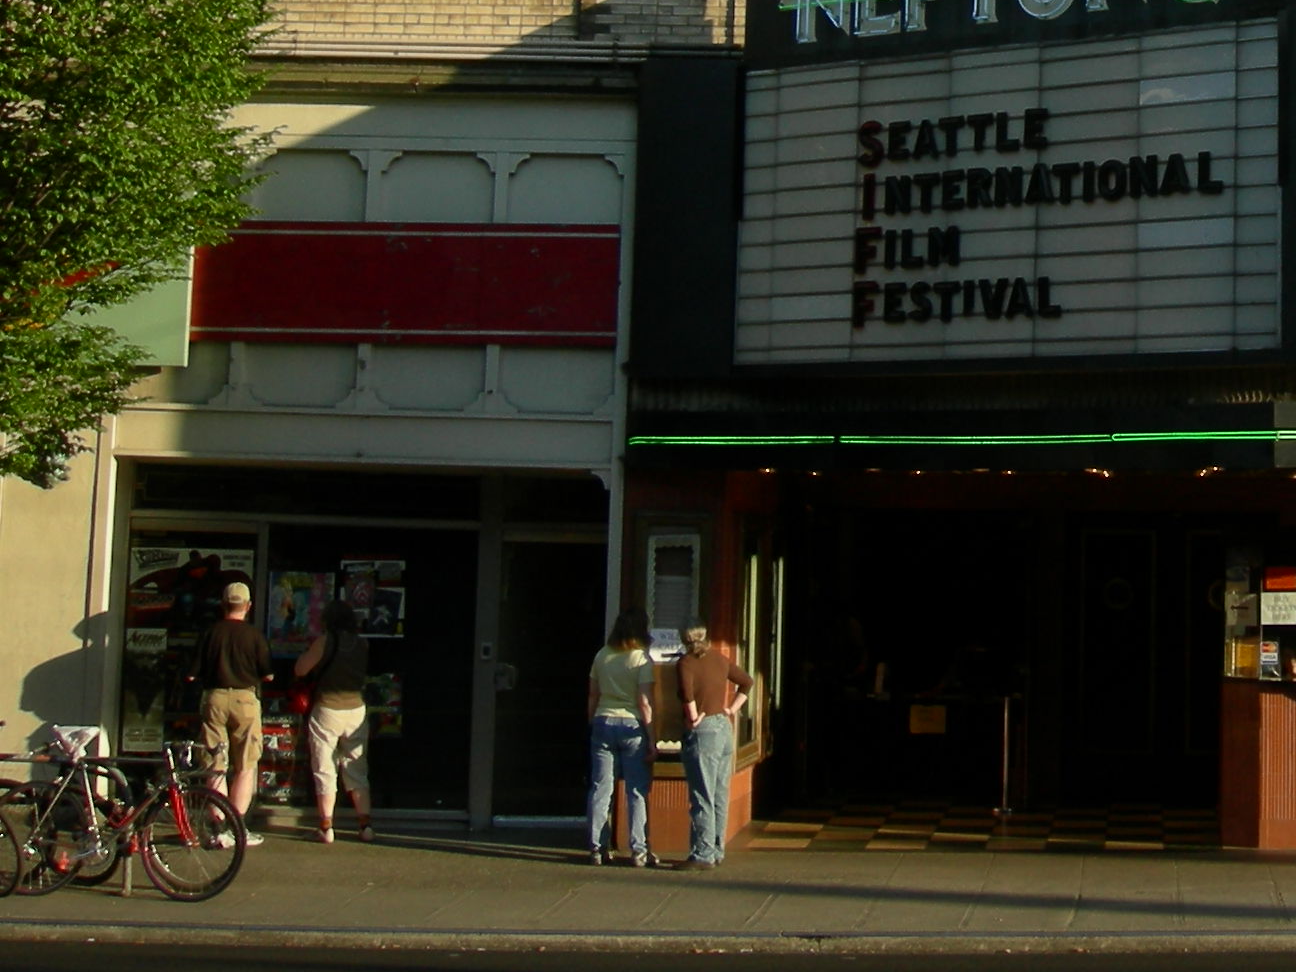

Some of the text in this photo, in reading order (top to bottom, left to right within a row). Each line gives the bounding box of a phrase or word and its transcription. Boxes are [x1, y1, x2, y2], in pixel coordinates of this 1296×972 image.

[857, 108, 1050, 168] SEATTLE
[859, 151, 1224, 221] INTERNATIONAL
[853, 226, 961, 275] FILM
[851, 276, 1063, 330] FESTIVAL
